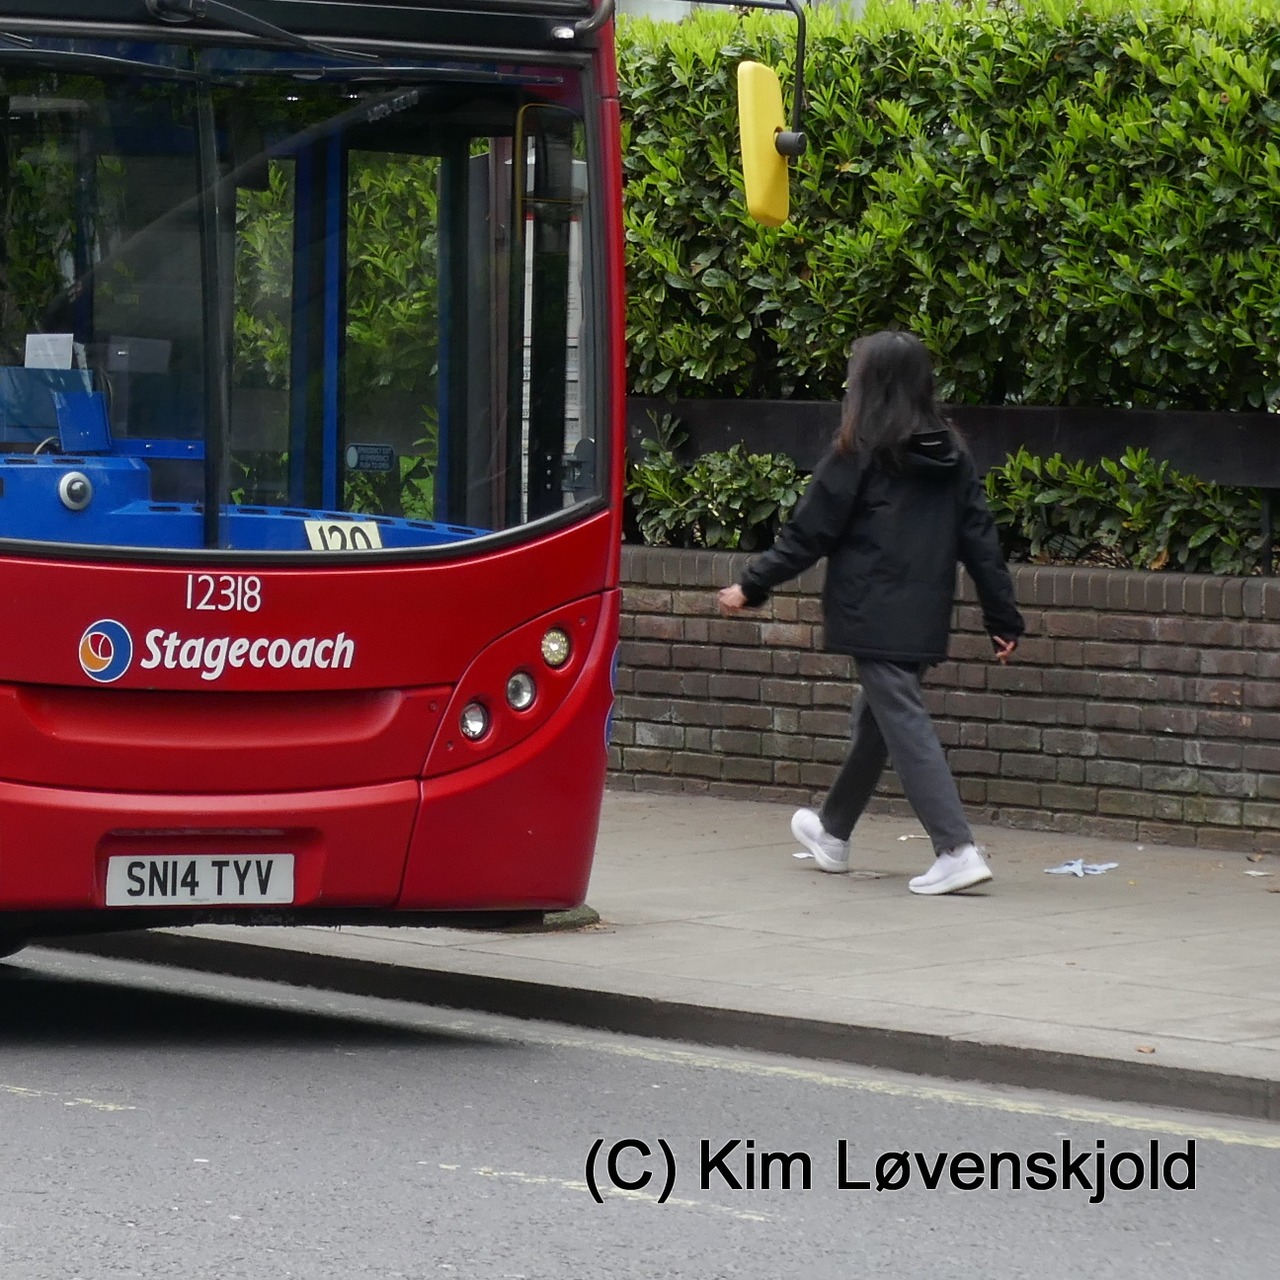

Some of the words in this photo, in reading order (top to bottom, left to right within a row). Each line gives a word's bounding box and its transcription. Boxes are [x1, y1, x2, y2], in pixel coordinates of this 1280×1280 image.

[186, 574, 261, 612] 12318
[140, 628, 355, 681] Stagecoach
[126, 860, 200, 897] SN14
[211, 859, 274, 896] TYV
